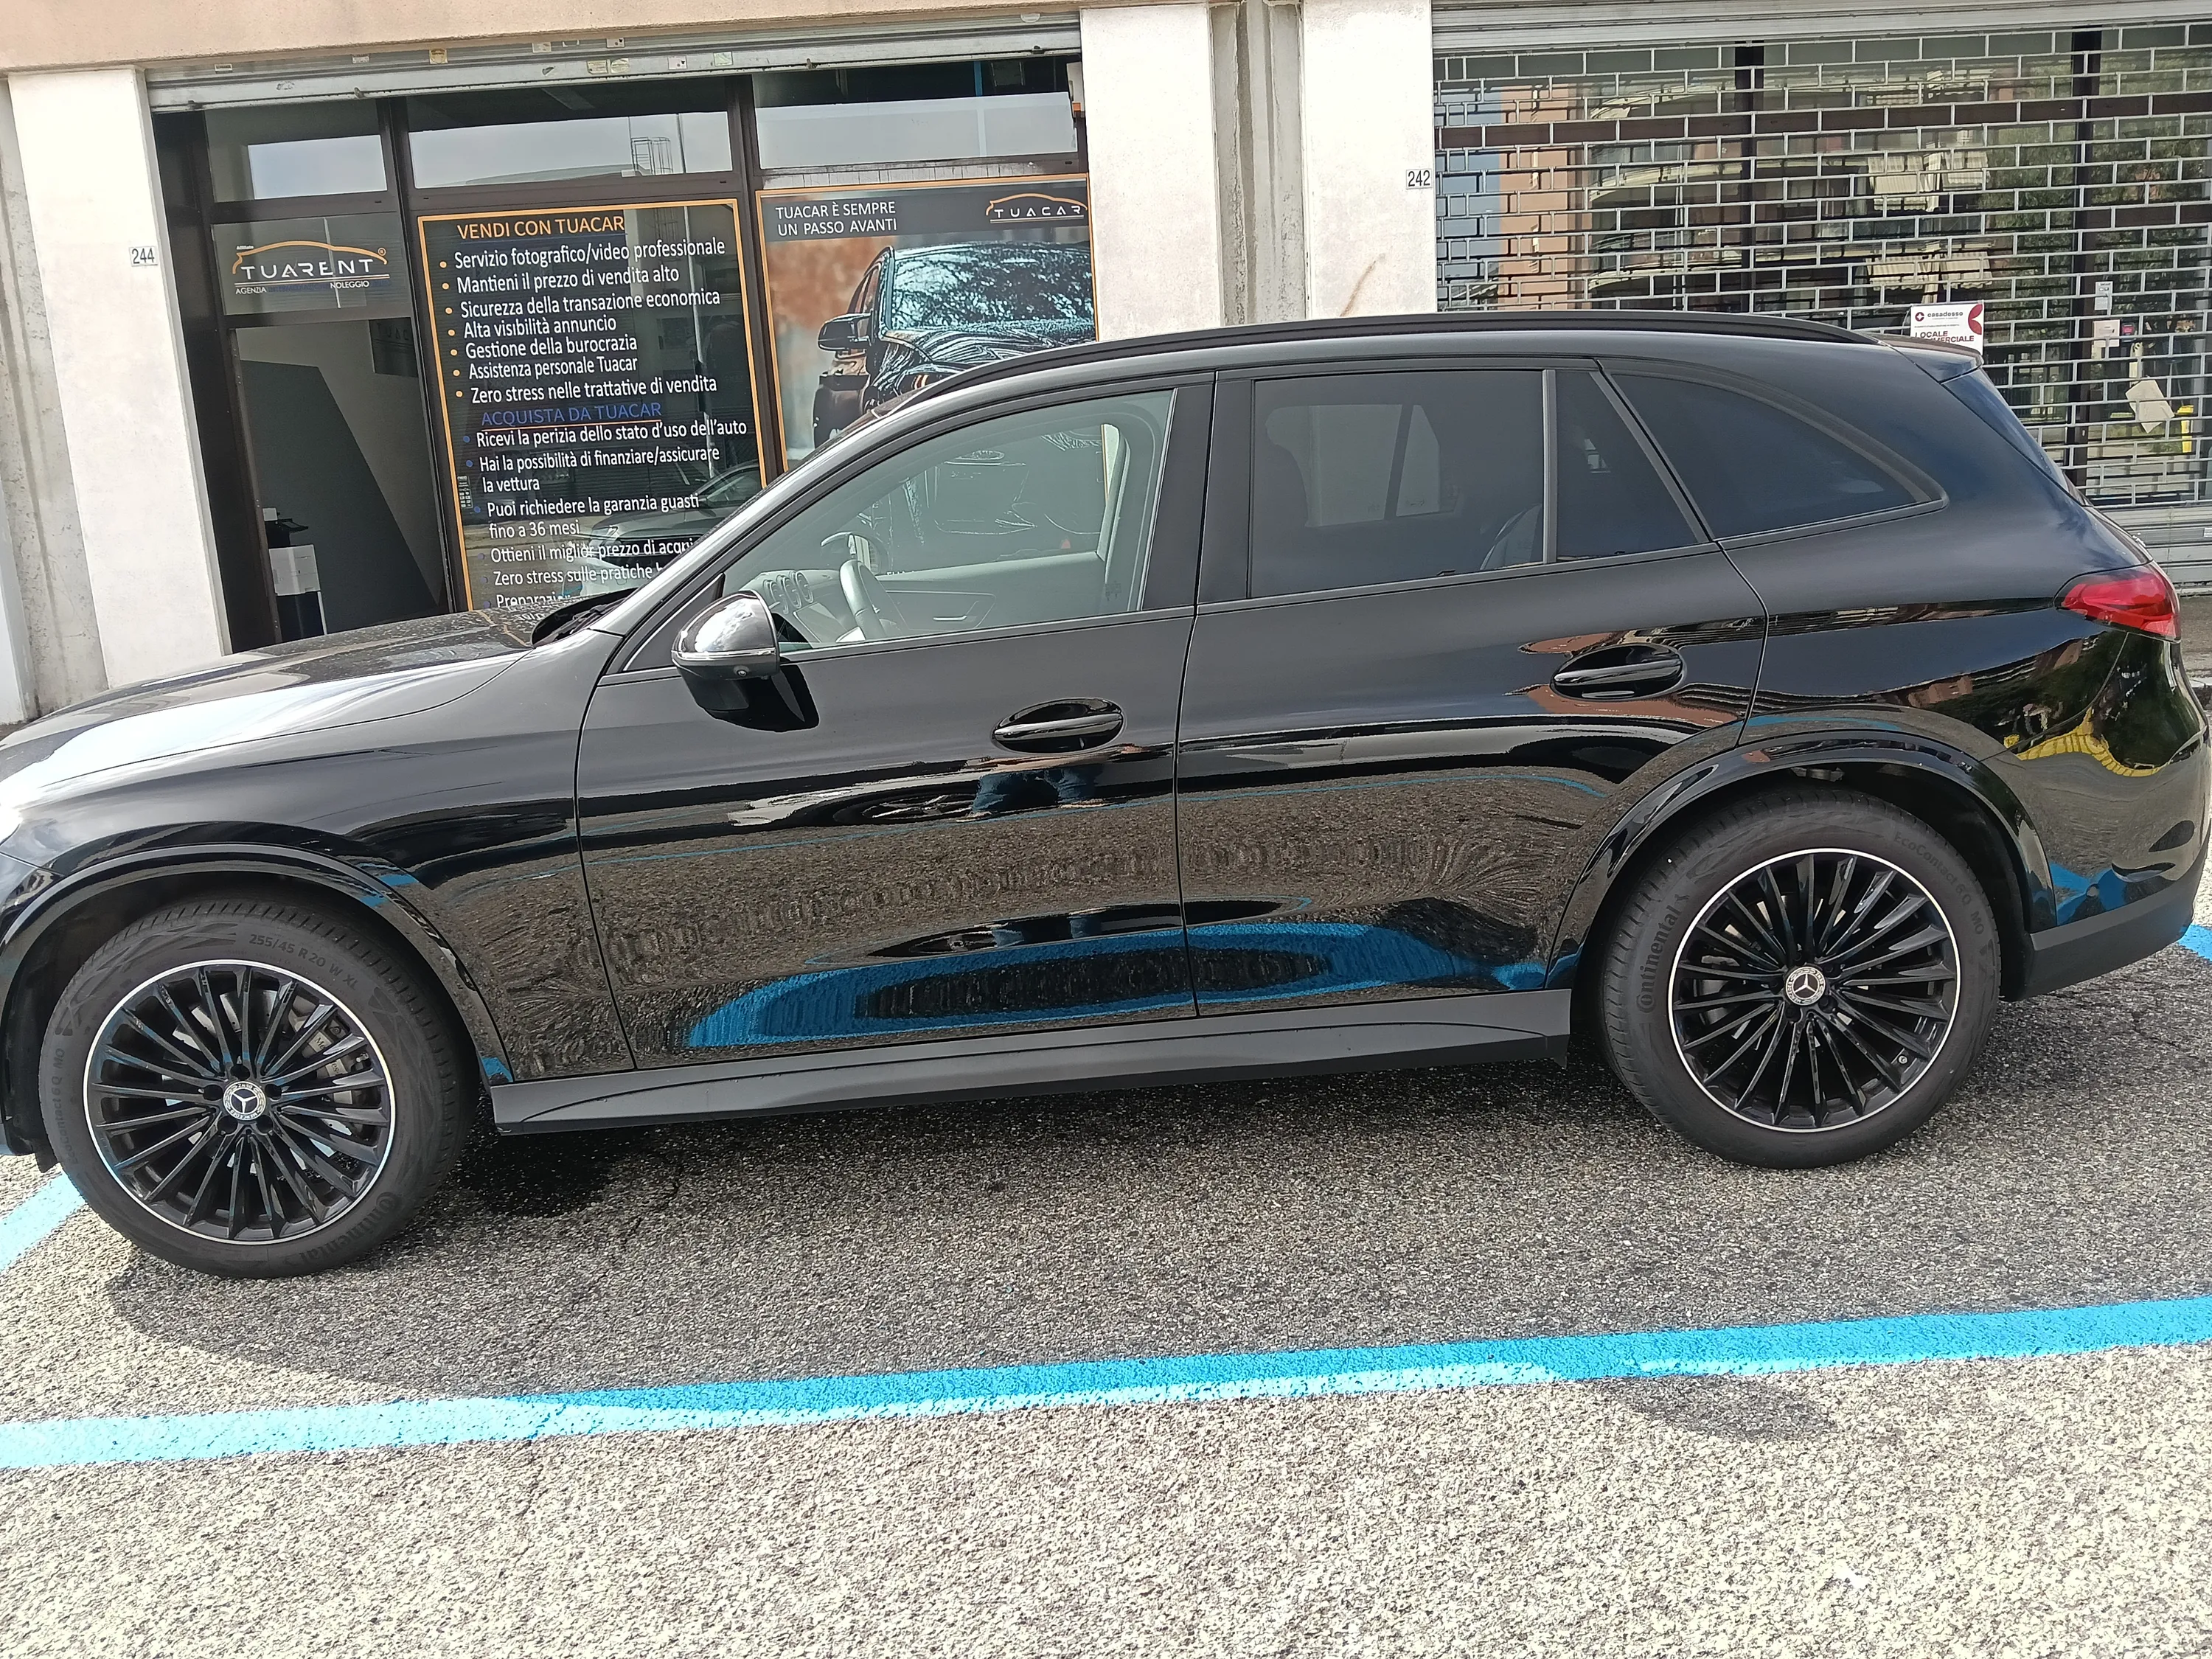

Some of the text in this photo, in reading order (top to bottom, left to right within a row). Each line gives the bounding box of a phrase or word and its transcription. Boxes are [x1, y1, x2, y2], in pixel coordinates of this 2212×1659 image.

[1408, 170, 1430, 187] 242
[776, 201, 896, 220] TUACAR È SEMPRE
[994, 205, 1082, 220] TUACAR
[456, 216, 625, 240] VENDI CON TUACAR
[777, 218, 897, 237] UN PASSO AVANTI
[131, 247, 156, 264] 244
[454, 236, 726, 269] Servizio fotografico/video professionale
[240, 258, 375, 281] TUARENT
[456, 264, 679, 293] Mantieni il prezzo di vendita alto
[235, 286, 267, 295] AGENZIA
[330, 279, 370, 290] NOLEGGIO
[460, 288, 720, 319] Sicurezza della transazione economica
[464, 314, 616, 338] Alta visibilità annuncio
[1915, 330, 1949, 338] LOCALE
[465, 333, 638, 359] Gestione della burocrazia
[469, 355, 638, 380] Assistenza personale Tuacar
[470, 374, 717, 404] Zero stress nelle trattative di vendita
[481, 402, 661, 426] ACQUISTA DA TUACAR
[476, 419, 747, 448] Ricevi la perizia dello stato d'uso dell'auto
[479, 445, 720, 473] Hai la possibilità di finanziare/assicurare
[482, 476, 494, 493] la
[495, 476, 540, 492] vettura
[487, 492, 699, 518] Puoi richiedere la garanzia guasti
[488, 519, 579, 539] fino a 36 mesi
[490, 545, 535, 563] Ottieni
[538, 544, 546, 560] il
[550, 543, 594, 562] miglior
[598, 539, 638, 559] prezzo
[643, 538, 656, 555] di
[493, 571, 524, 586] Zero
[526, 570, 564, 584] stress
[567, 565, 598, 582] sulle
[601, 563, 653, 580] pratiche
[1893, 831, 1958, 886] EcoContact
[1969, 910, 1985, 935] MO
[248, 933, 296, 954] 255/45
[298, 947, 309, 960] R
[308, 952, 327, 967] 20
[329, 962, 344, 977] W
[1635, 904, 1683, 1014] Continental
[52, 1047, 66, 1069] MO
[299, 1192, 397, 1263] Continental
